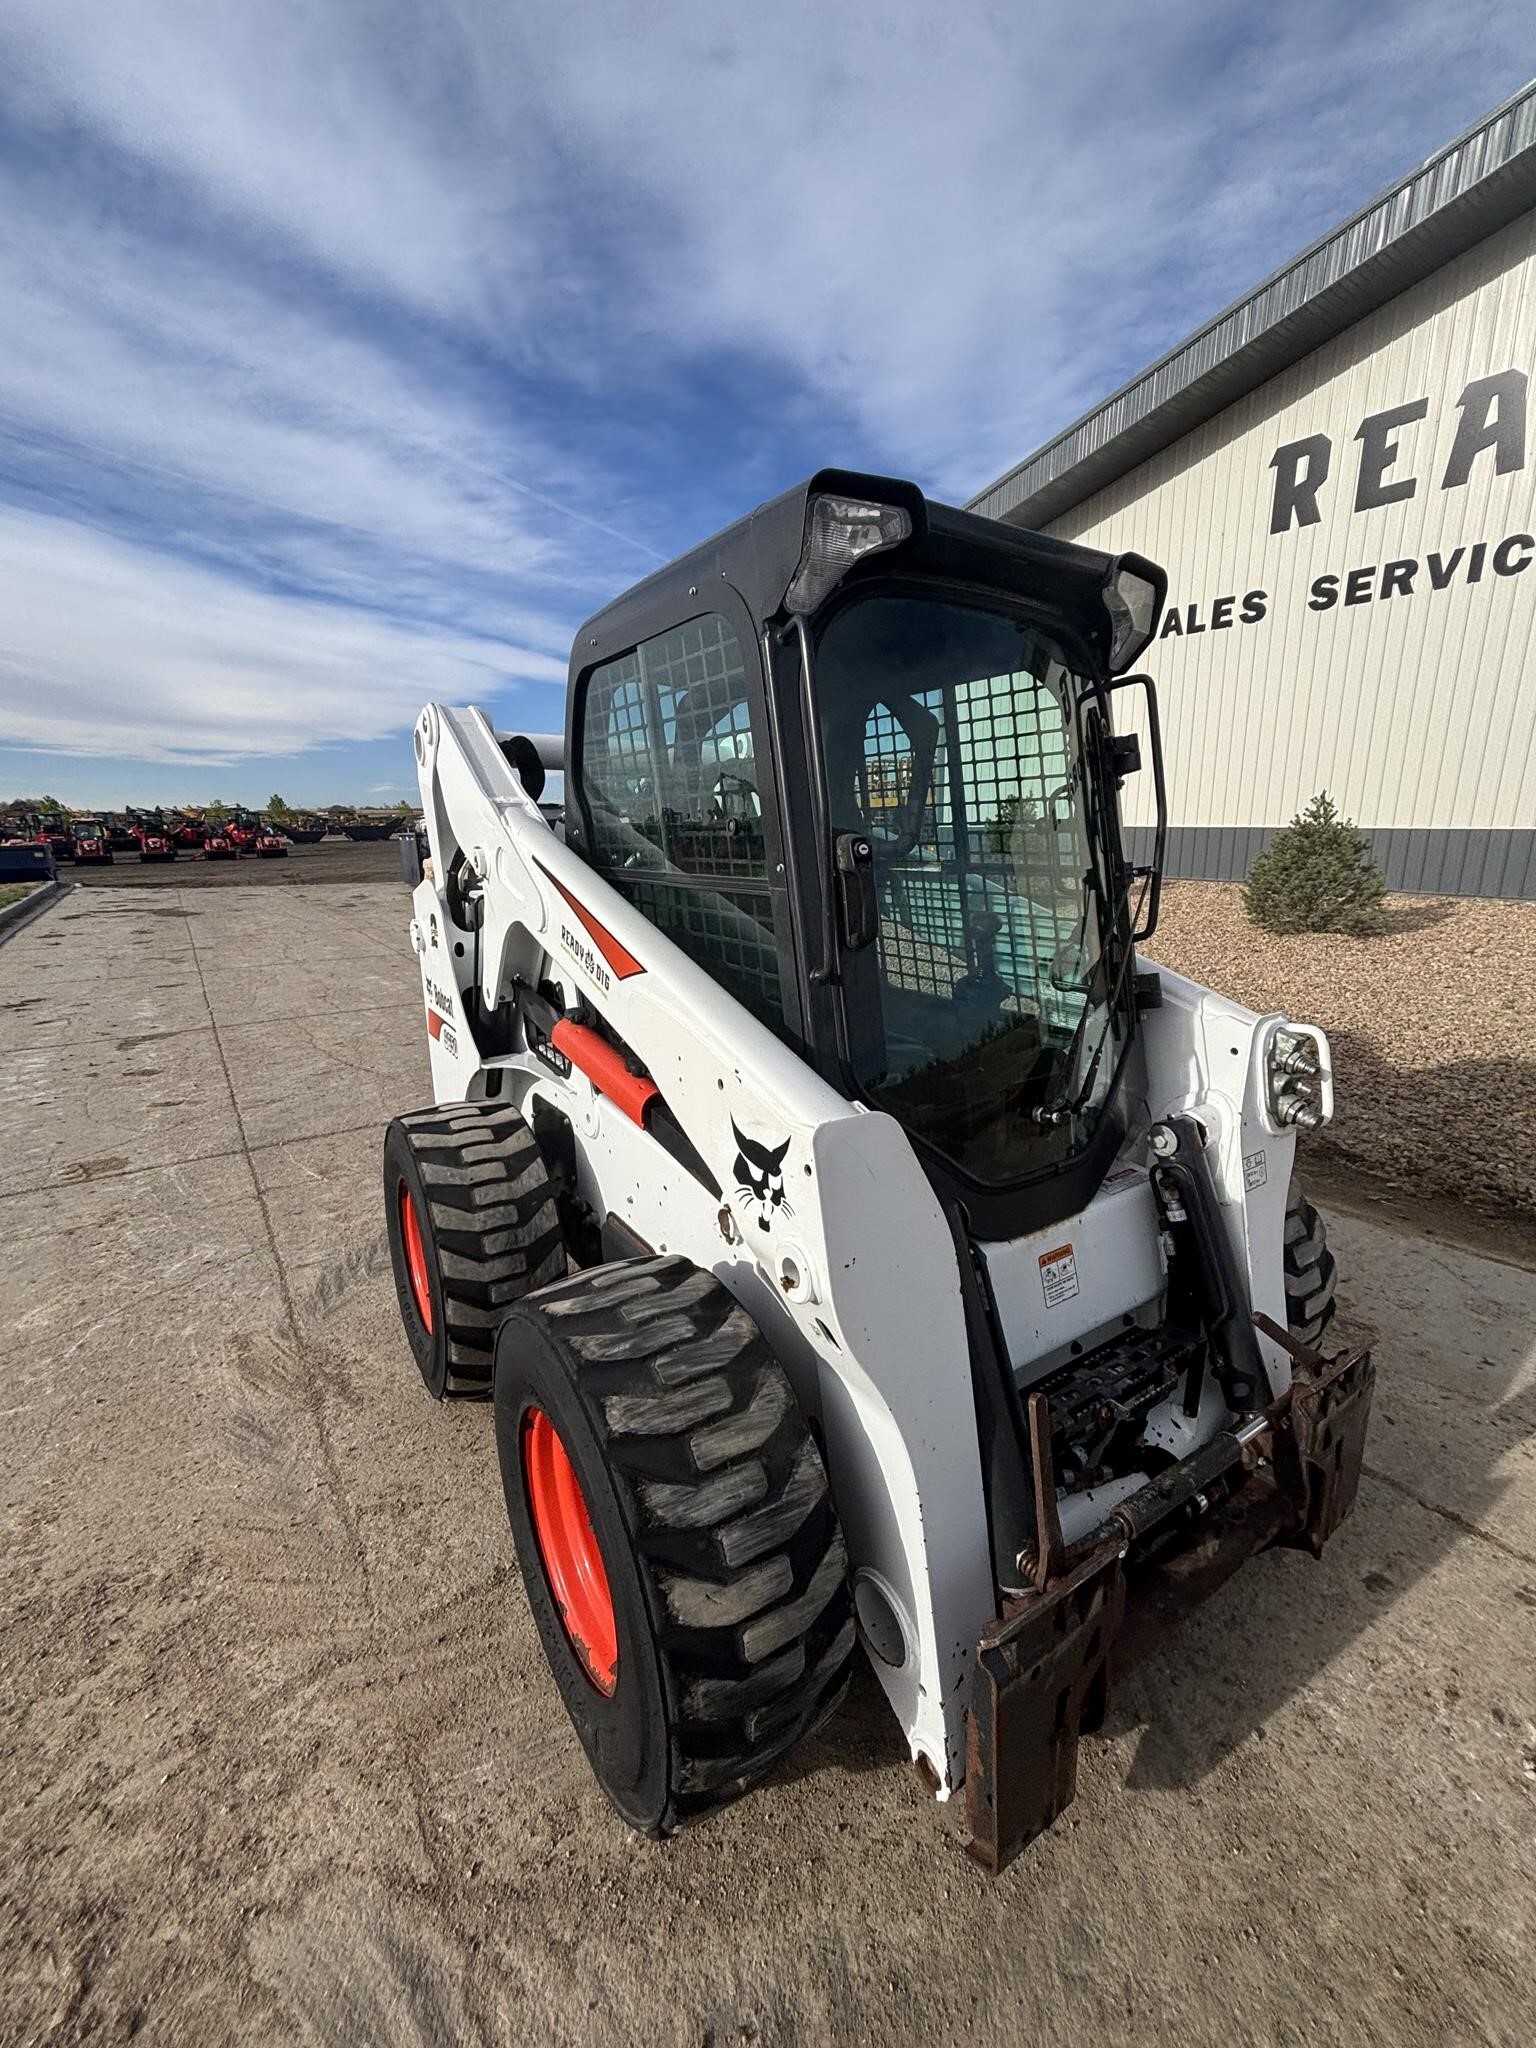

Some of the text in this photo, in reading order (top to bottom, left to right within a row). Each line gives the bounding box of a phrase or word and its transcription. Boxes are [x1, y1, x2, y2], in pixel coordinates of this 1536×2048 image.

[1268, 367, 1529, 536] REA
[1159, 533, 1536, 640] ALES SERVIC
[561, 924, 611, 992] READY DIG
[1047, 1247, 1071, 1262] WARNING
